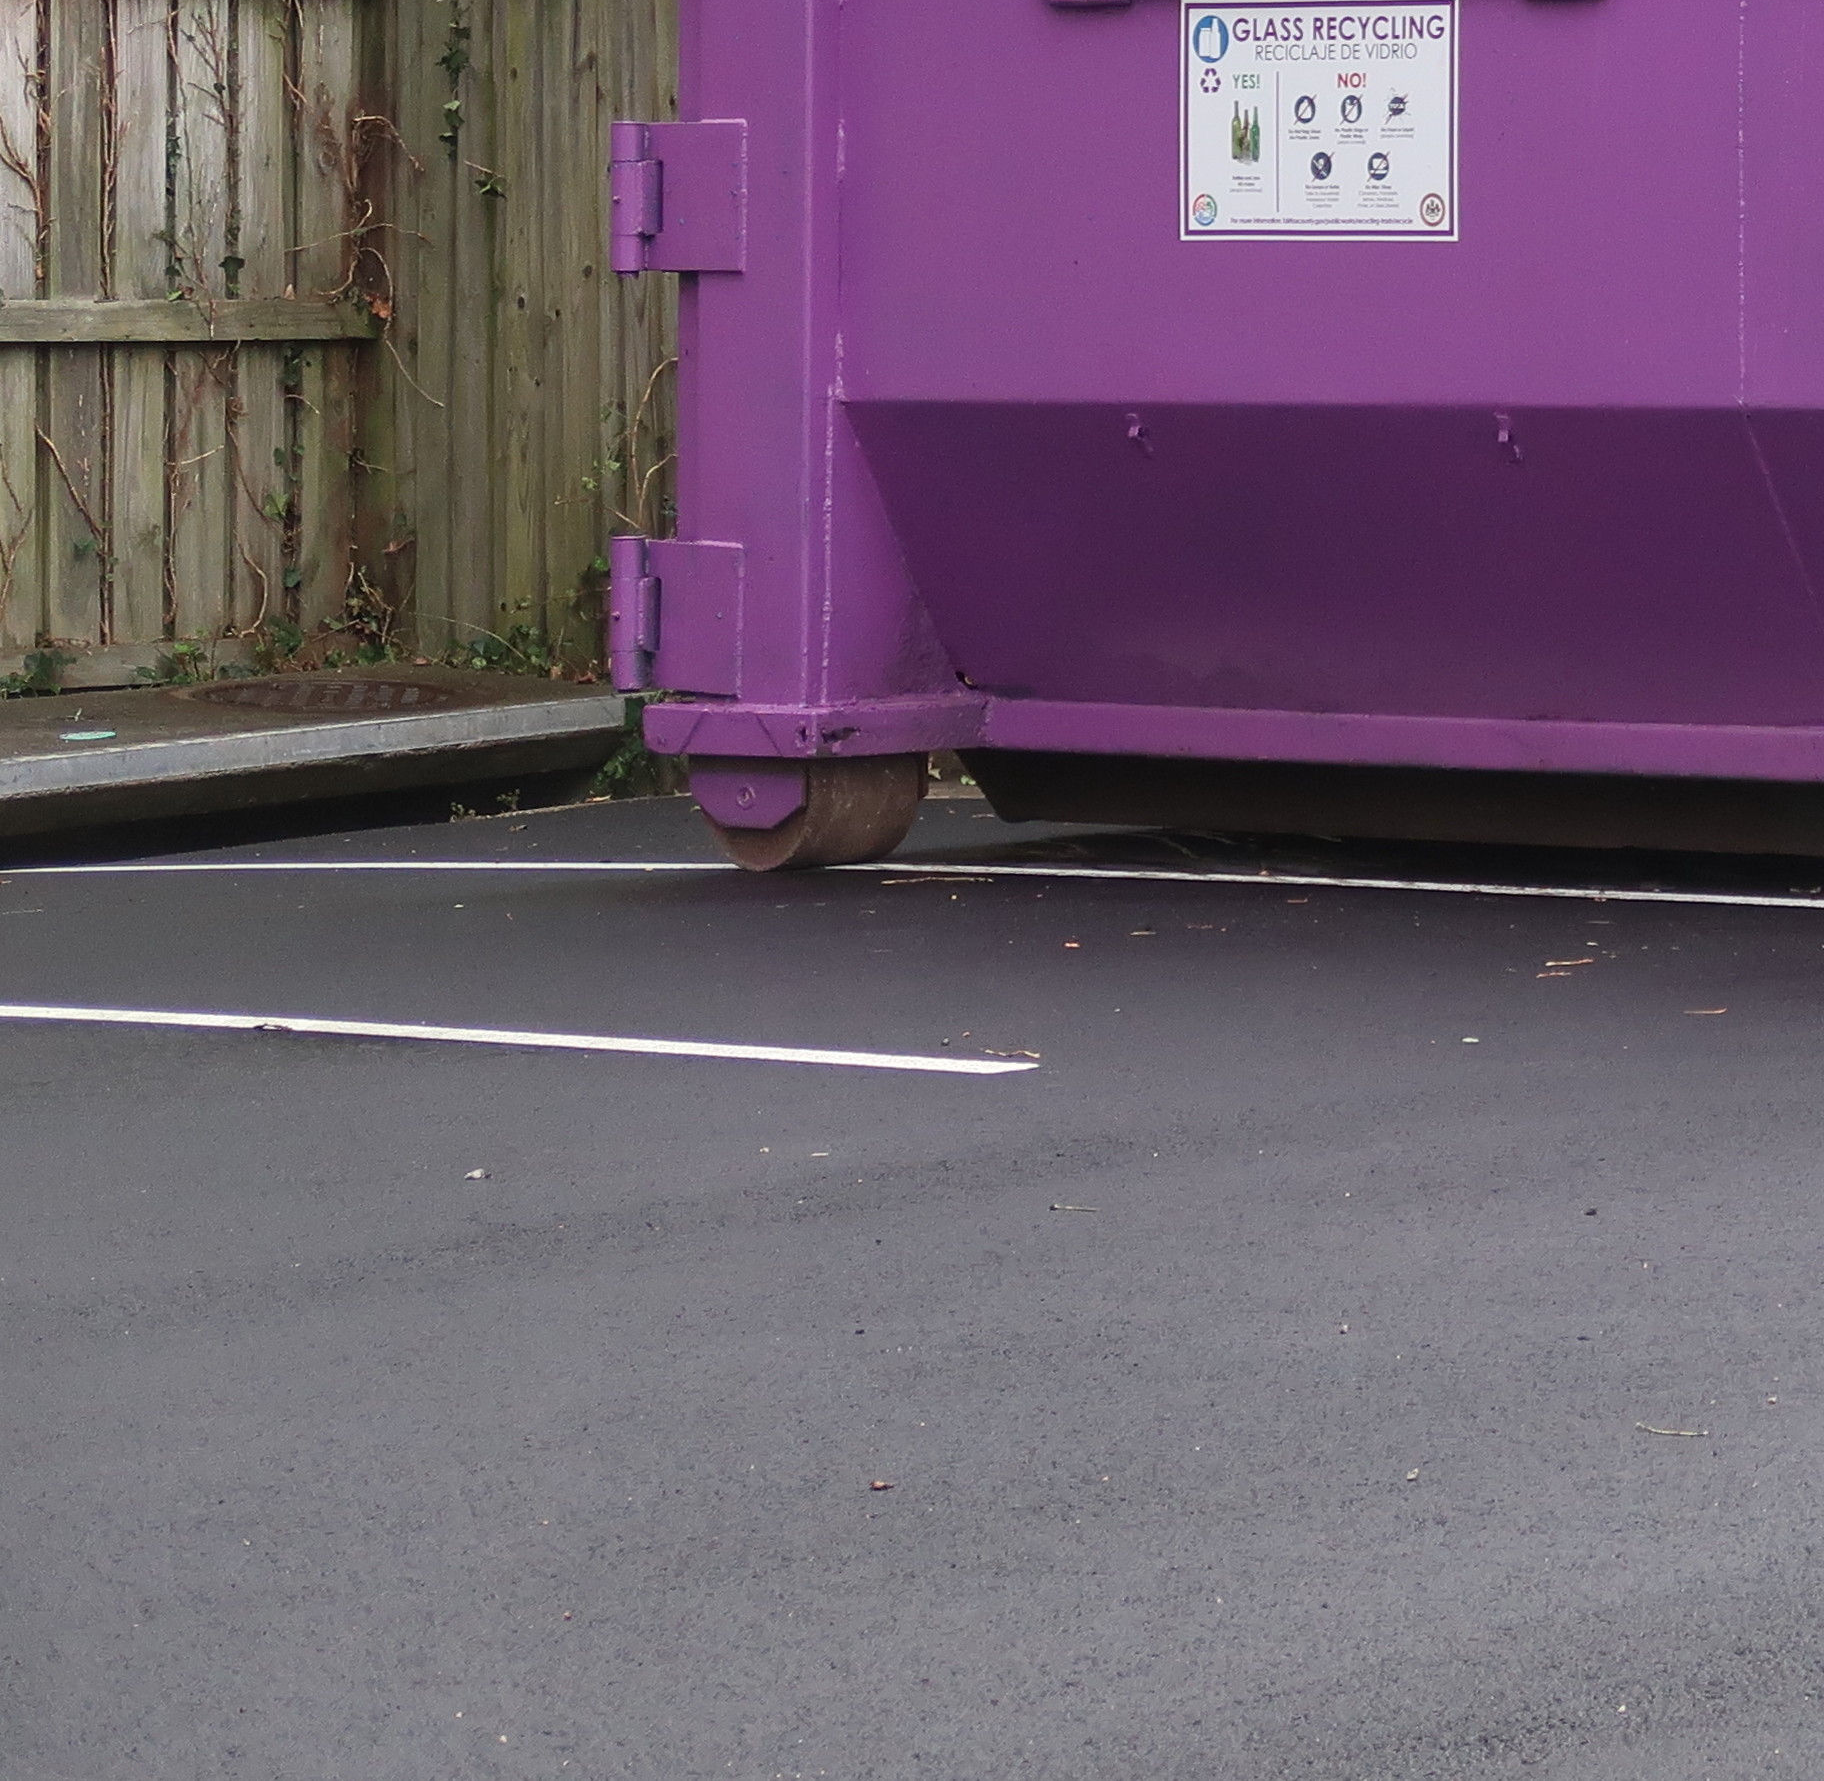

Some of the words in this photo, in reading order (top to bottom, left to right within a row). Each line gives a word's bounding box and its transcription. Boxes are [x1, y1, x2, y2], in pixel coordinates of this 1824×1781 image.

[1232, 18, 1304, 42] GLASS
[1312, 15, 1445, 40] RECYCLING
[1255, 44, 1336, 61] RECICLAJE
[1341, 44, 1360, 60] DE
[1365, 43, 1418, 59] VIDRIO
[1232, 74, 1260, 89] YES!
[1337, 72, 1366, 88] NO!
